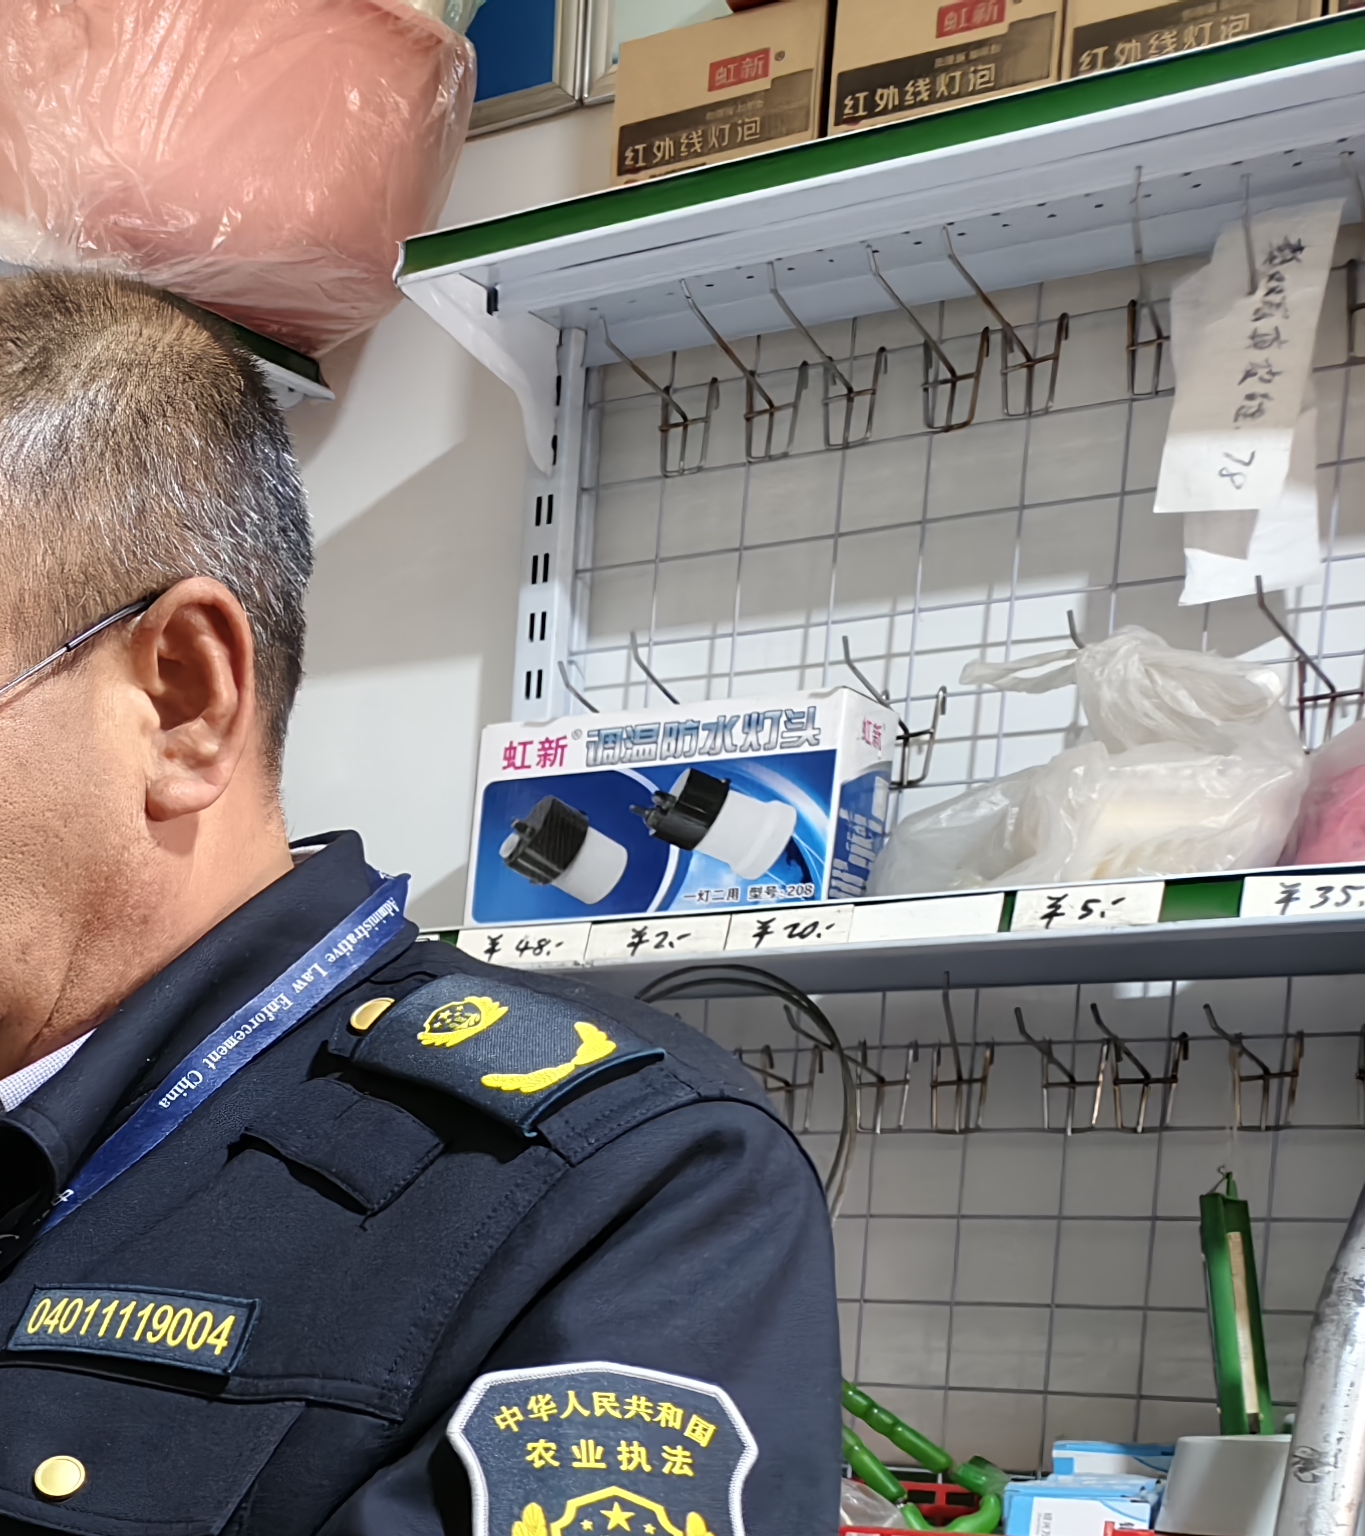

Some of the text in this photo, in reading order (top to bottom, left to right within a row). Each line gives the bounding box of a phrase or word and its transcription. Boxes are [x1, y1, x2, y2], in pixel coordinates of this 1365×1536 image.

[1079, 13, 1250, 73] 红外线灯泡
[843, 64, 996, 120] 红外线灯泡
[624, 117, 761, 168] 红外线灯泡
[502, 736, 568, 771] 虹新
[585, 706, 821, 767] 调温防水灯头
[682, 886, 739, 902] 一灯二用
[158, 897, 400, 1108] Administrative Law Enforcement China
[27, 1296, 236, 1356] 04011119004
[493, 1391, 717, 1449] 中华人民共和国
[524, 1438, 695, 1477] 农业执法
